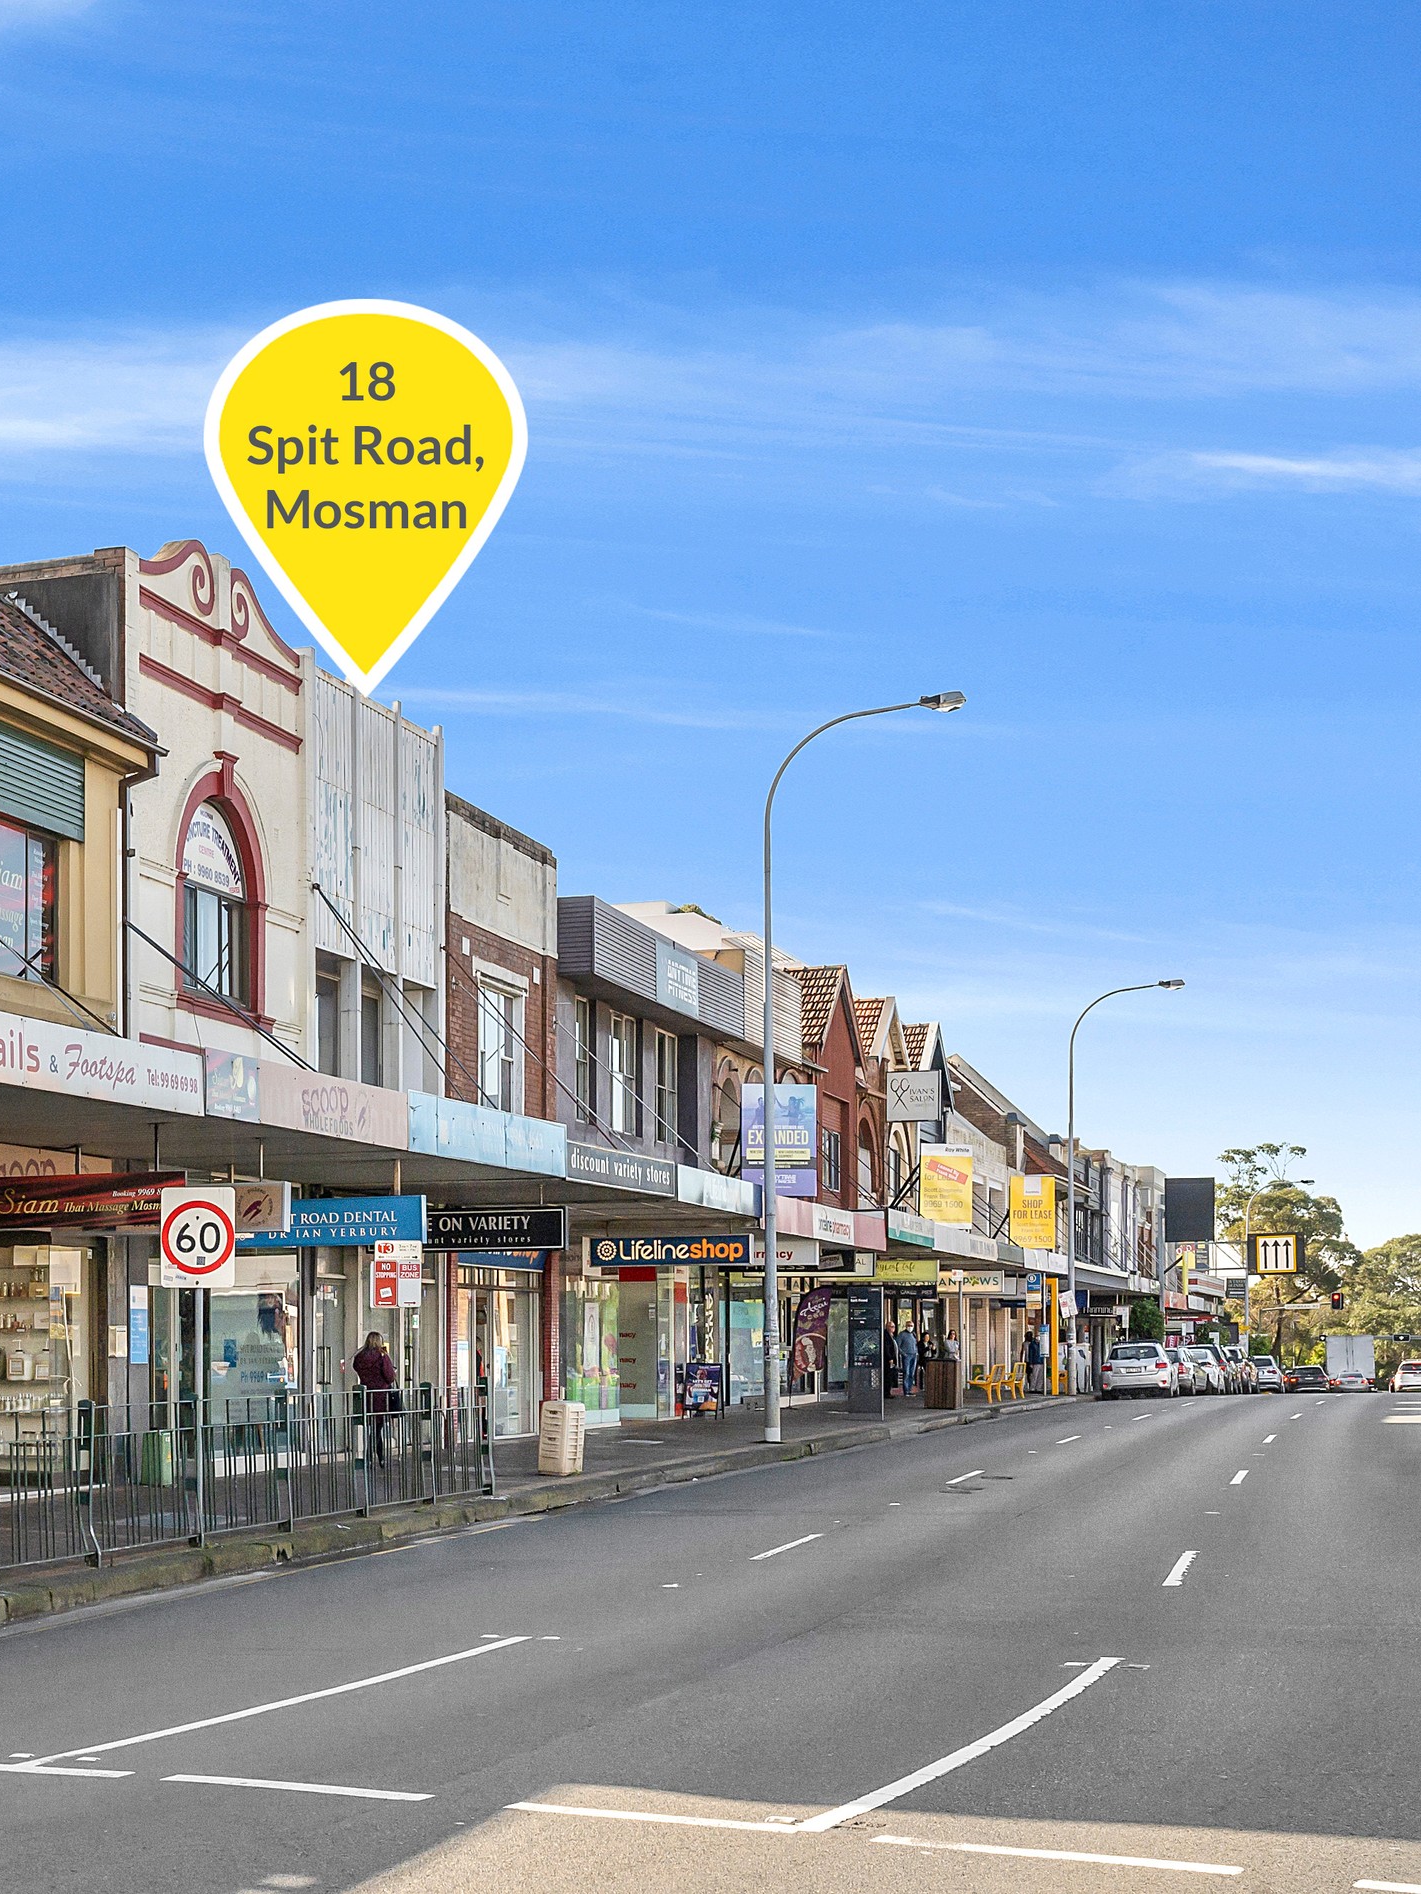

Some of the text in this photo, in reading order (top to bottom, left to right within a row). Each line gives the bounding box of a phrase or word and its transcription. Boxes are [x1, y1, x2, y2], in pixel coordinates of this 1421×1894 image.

[211, 826, 241, 886] TREATMENT
[49, 1054, 59, 1074] &
[64, 1043, 138, 1091] Footspa
[146, 1068, 160, 1088] Tel:
[160, 1070, 170, 1089] 99
[170, 1072, 180, 1090] 69
[180, 1074, 189, 1092] 69
[189, 1076, 198, 1094] 98
[909, 1087, 935, 1095] IVAN'S
[747, 1130, 809, 1145] EXNDED
[570, 1147, 671, 1186] discount variety stores
[112, 1190, 136, 1198] Booking
[137, 1188, 156, 1197] 9969
[63, 1201, 85, 1213] Thai
[86, 1202, 130, 1216] Massage
[131, 1200, 162, 1212] Mosm
[924, 1201, 964, 1209] 9969 1500
[1022, 1199, 1044, 1209] SHOP
[301, 1213, 339, 1225] ROAD
[344, 1211, 398, 1224] DENTAL
[1013, 1210, 1053, 1220] FOR LEASE
[439, 1217, 462, 1232] ON
[468, 1215, 531, 1231] VARIETY
[176, 1221, 221, 1254] 60
[268, 1227, 398, 1239] DR IAN YERBURY
[1013, 1235, 1053, 1243] 9969 1500
[451, 1236, 490, 1246] variety
[379, 1243, 393, 1254] T3
[619, 1238, 744, 1262] Lifelineshop
[381, 1263, 391, 1271] NO
